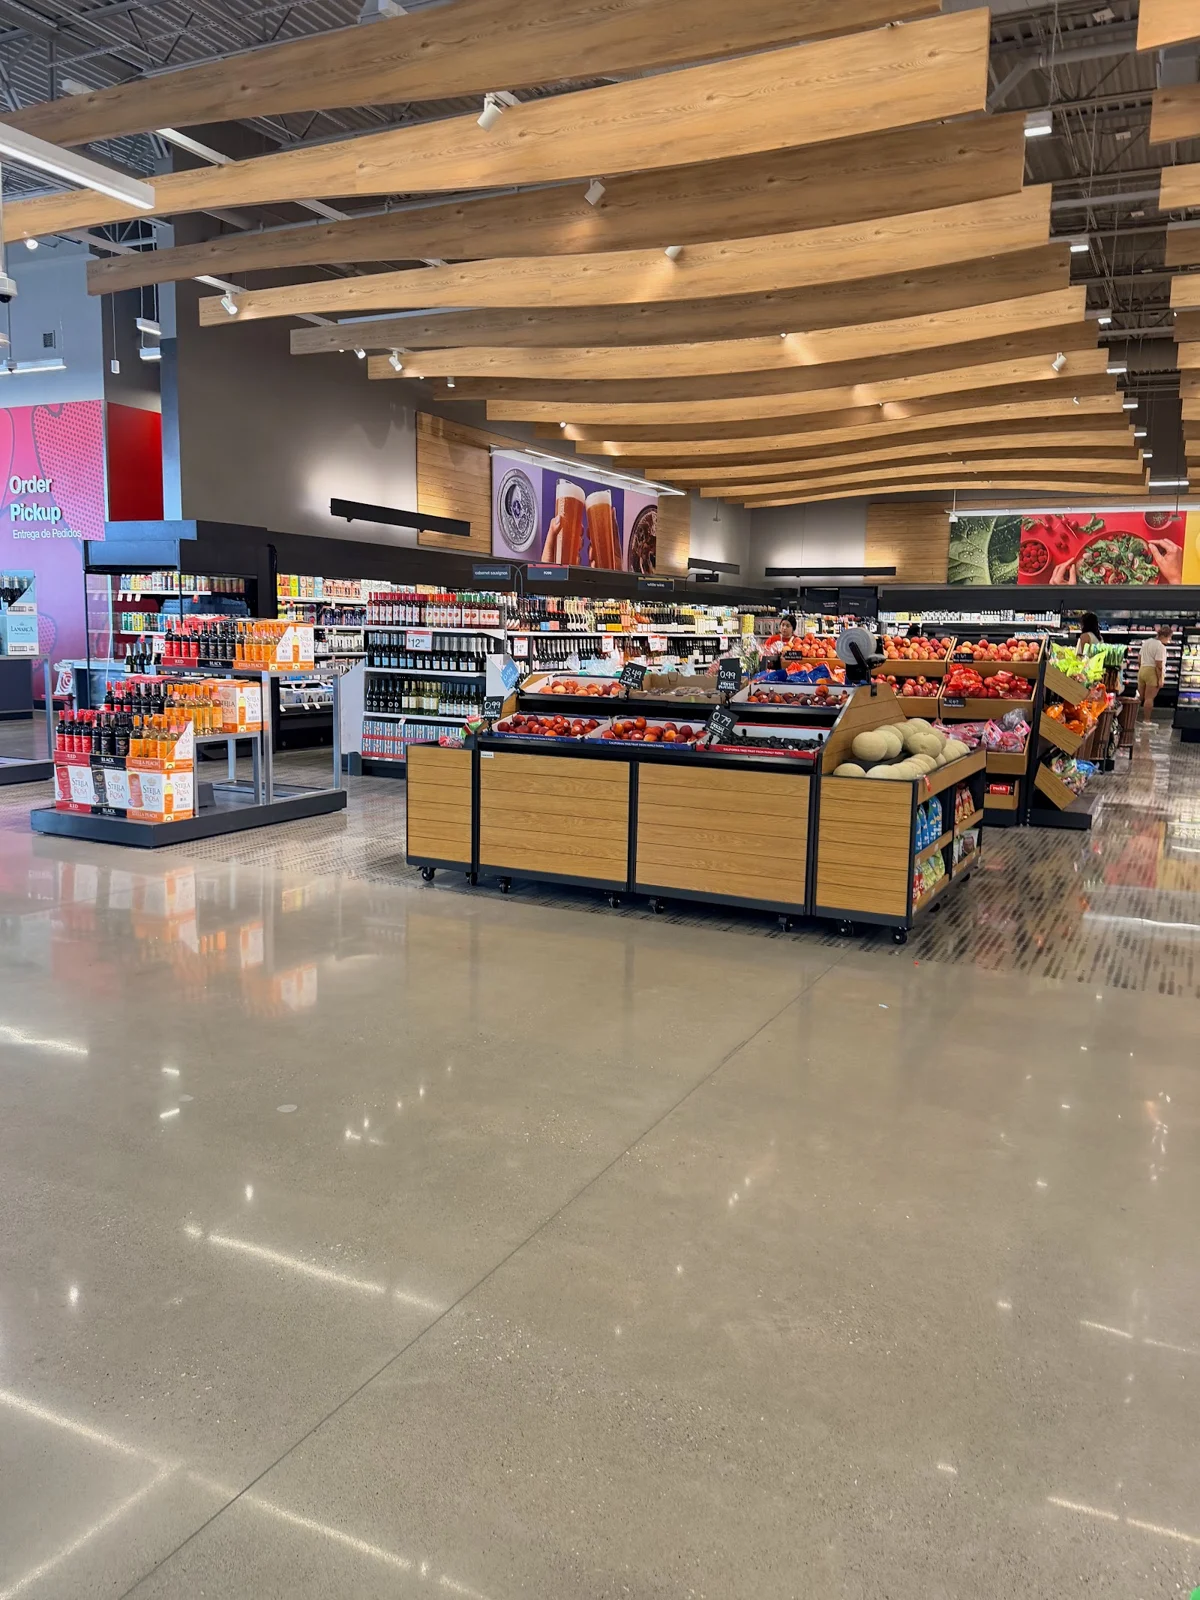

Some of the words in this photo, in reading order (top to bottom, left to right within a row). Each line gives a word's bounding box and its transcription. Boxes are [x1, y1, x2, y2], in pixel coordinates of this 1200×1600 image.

[9, 475, 53, 494] Order
[10, 503, 62, 524] Pickup
[13, 530, 39, 540] Entrega
[41, 529, 50, 538] de
[52, 528, 82, 538] Pedidos
[72, 778, 88, 788] STELLA
[108, 781, 125, 792] STELLA
[74, 786, 87, 796] ROSA
[110, 790, 124, 800] ROSA
[142, 785, 162, 796] STELLA
[144, 794, 160, 803] ROSA
